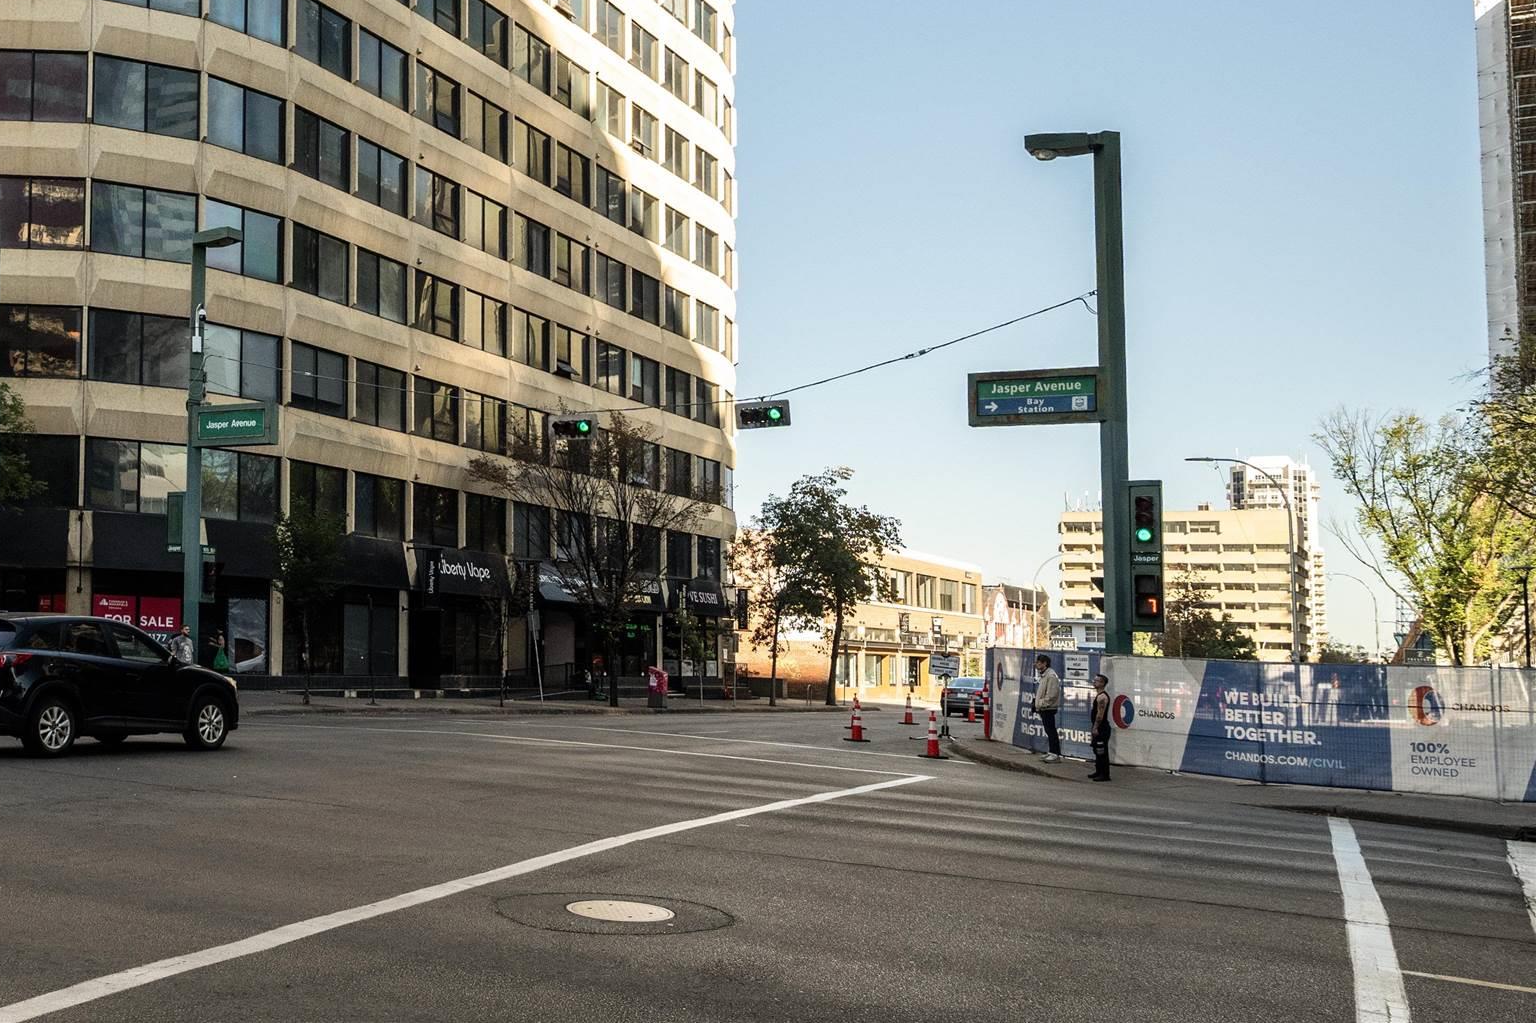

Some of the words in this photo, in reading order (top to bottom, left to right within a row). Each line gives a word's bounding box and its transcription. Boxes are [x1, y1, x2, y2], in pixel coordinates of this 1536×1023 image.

[991, 383, 1031, 395] Jasper
[1034, 381, 1082, 392] Avenue
[1017, 404, 1055, 413] Station
[1026, 398, 1045, 407] Bay
[206, 420, 229, 430] Jasper
[231, 419, 257, 428] Avenue
[466, 561, 491, 581] Vape
[698, 592, 719, 605] SUSHI
[1148, 598, 1157, 613] 7
[140, 616, 174, 628] SALE
[1224, 690, 1249, 705] WE
[1252, 693, 1302, 708] BUILD
[1451, 702, 1511, 713] CHANDOS
[1139, 709, 1175, 720] CHANDOS
[1224, 709, 1285, 725] BETTER
[1224, 726, 1323, 745] TOGETHER.
[1410, 742, 1450, 754] 100%
[1225, 750, 1346, 769] CHANDOS.COM/CIVIL
[1410, 755, 1476, 767] EMPLOYEE
[1411, 766, 1459, 777] OWNED
